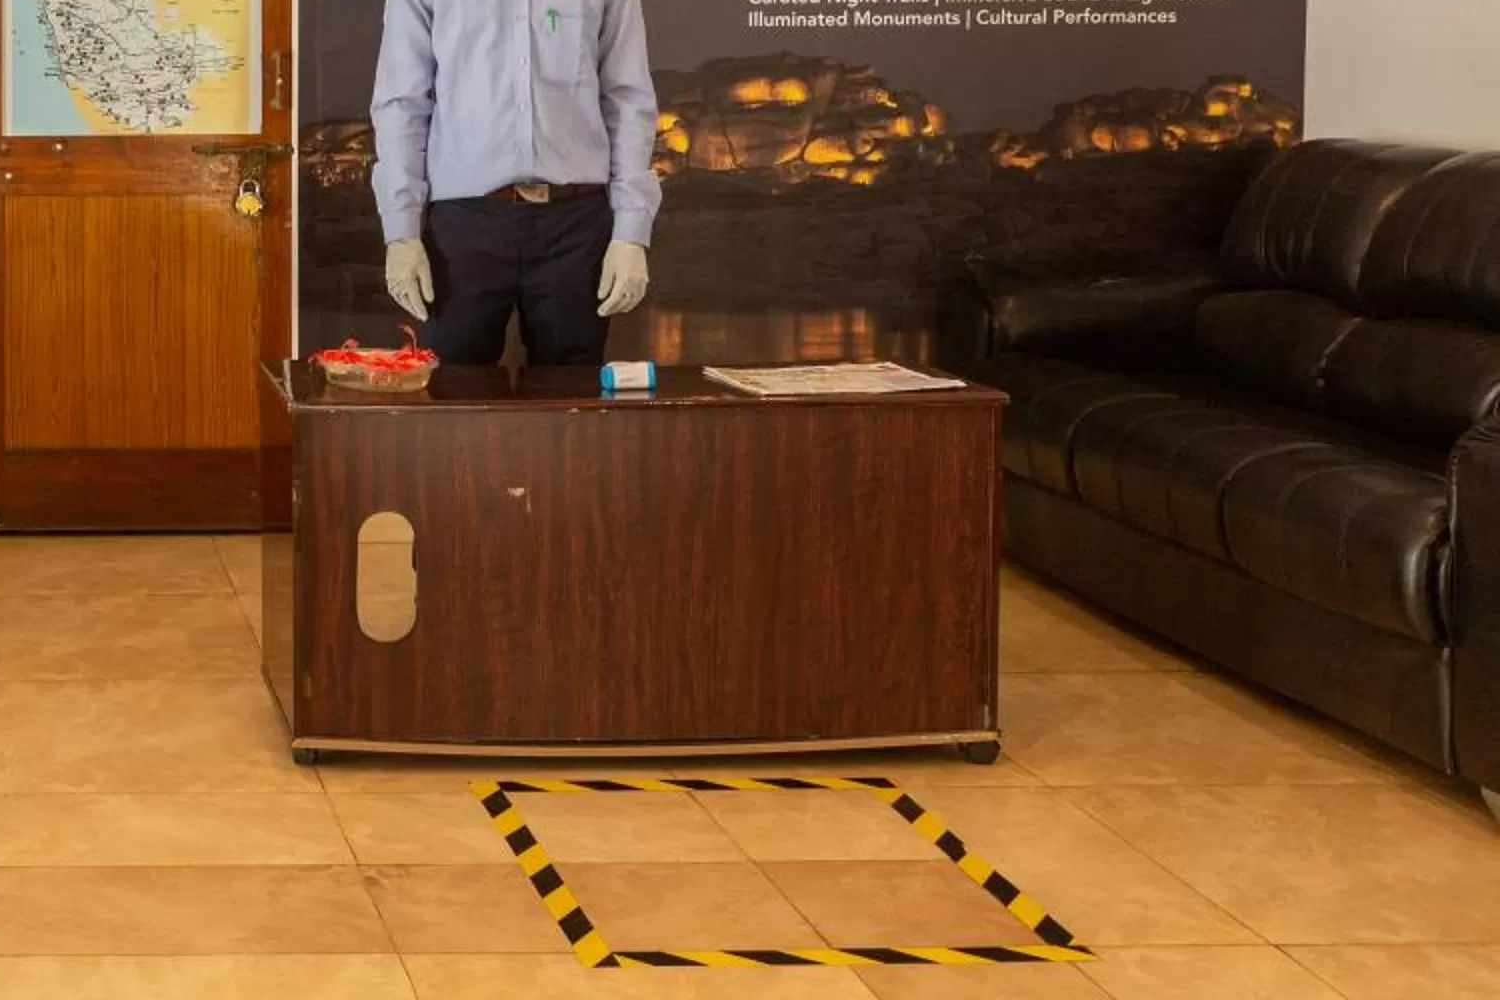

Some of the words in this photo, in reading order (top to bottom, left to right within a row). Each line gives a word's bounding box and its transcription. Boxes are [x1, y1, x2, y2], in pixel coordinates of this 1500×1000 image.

[748, 10, 847, 27] Illuminated
[854, 10, 961, 26] Monuments
[976, 8, 1047, 25] Cultural
[1053, 7, 1177, 25] Performances
